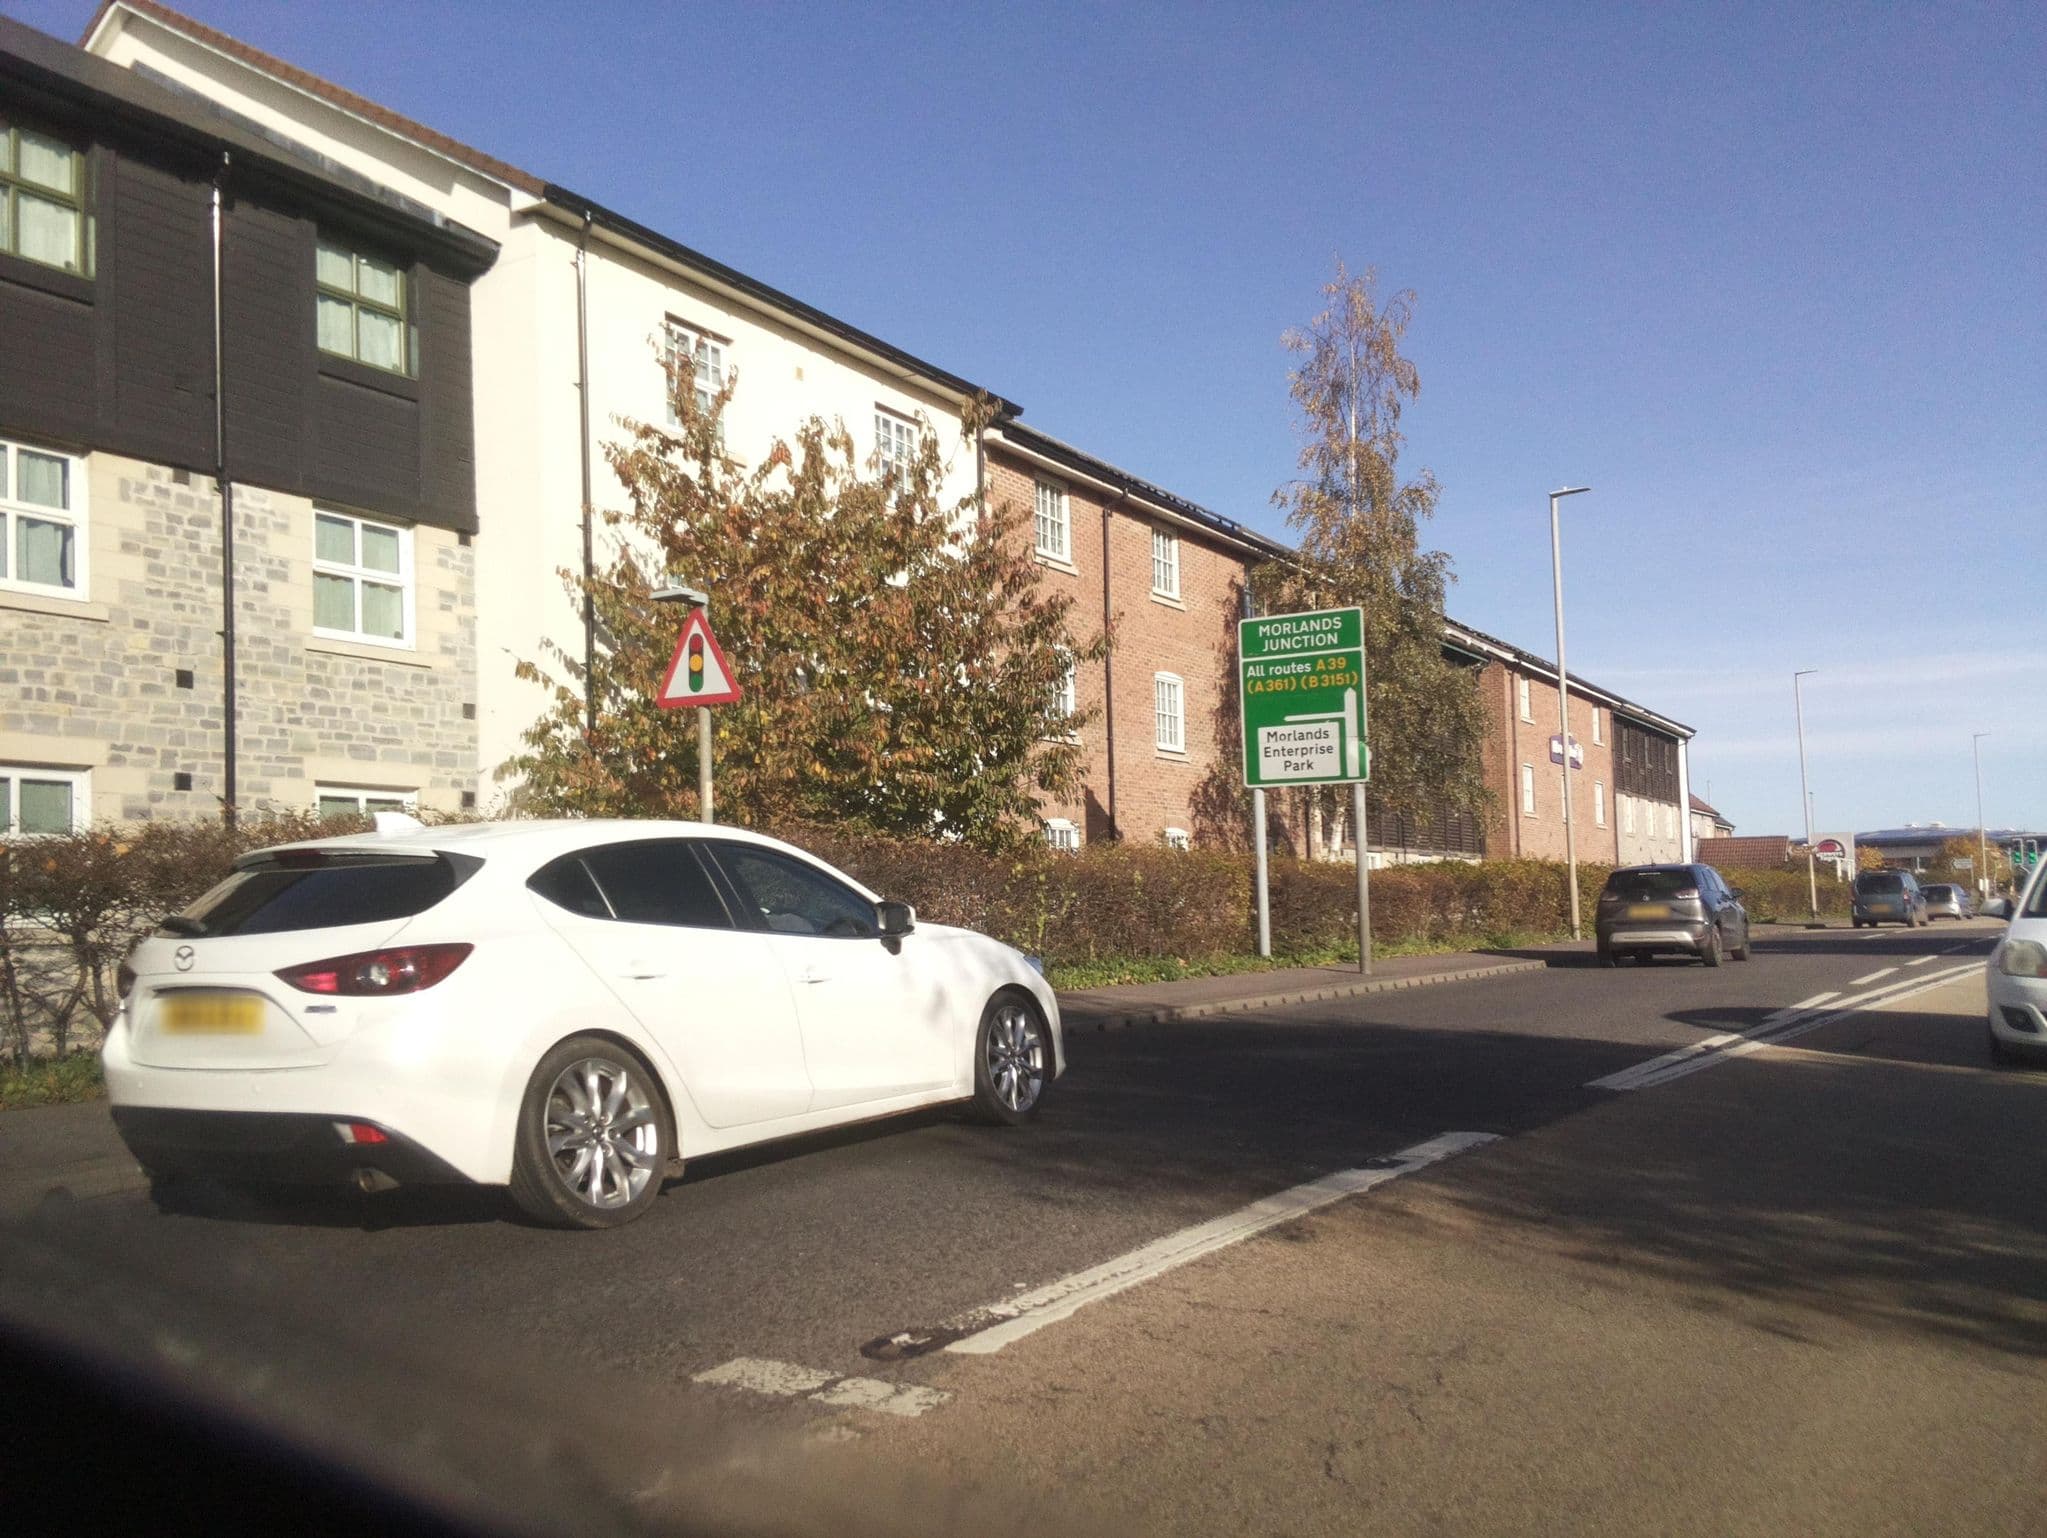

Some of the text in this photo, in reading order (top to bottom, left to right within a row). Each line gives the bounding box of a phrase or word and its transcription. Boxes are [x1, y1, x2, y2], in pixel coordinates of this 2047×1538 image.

[1258, 617, 1342, 637] MORLANDS
[1262, 632, 1338, 652] JUNCTION
[1246, 665, 1265, 677] All
[1269, 662, 1311, 675] routes
[1266, 728, 1330, 743] Morlands
[1264, 744, 1334, 760] Enterprise
[1283, 760, 1314, 772] Park
